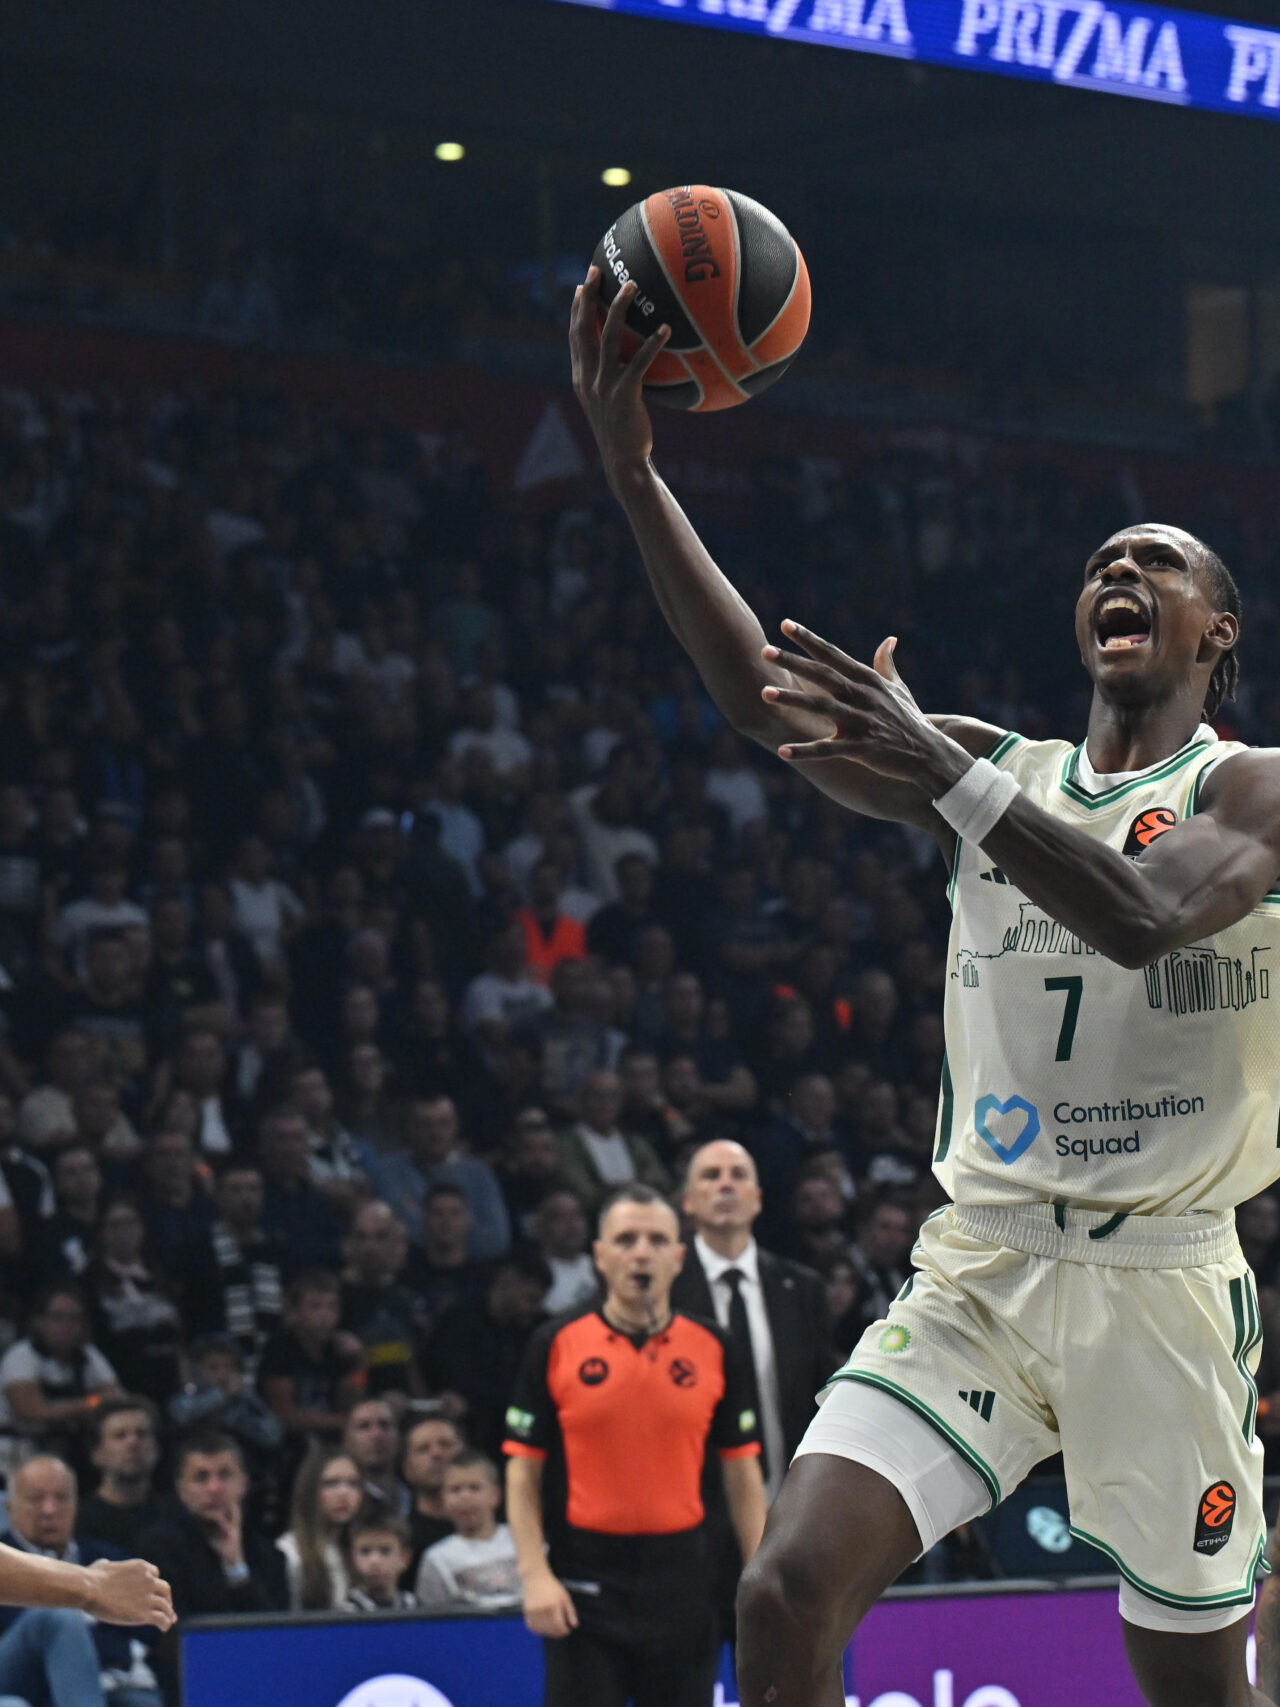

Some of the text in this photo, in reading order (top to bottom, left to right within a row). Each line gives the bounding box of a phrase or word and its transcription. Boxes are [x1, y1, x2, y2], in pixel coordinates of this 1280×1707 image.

[954, 0, 1190, 104] PRIZMA
[1044, 975, 1083, 1062] 7
[1053, 1095, 1204, 1124] Contribution
[1055, 1130, 1140, 1162] Squad
[1196, 1534, 1229, 1548] ETIHAD
